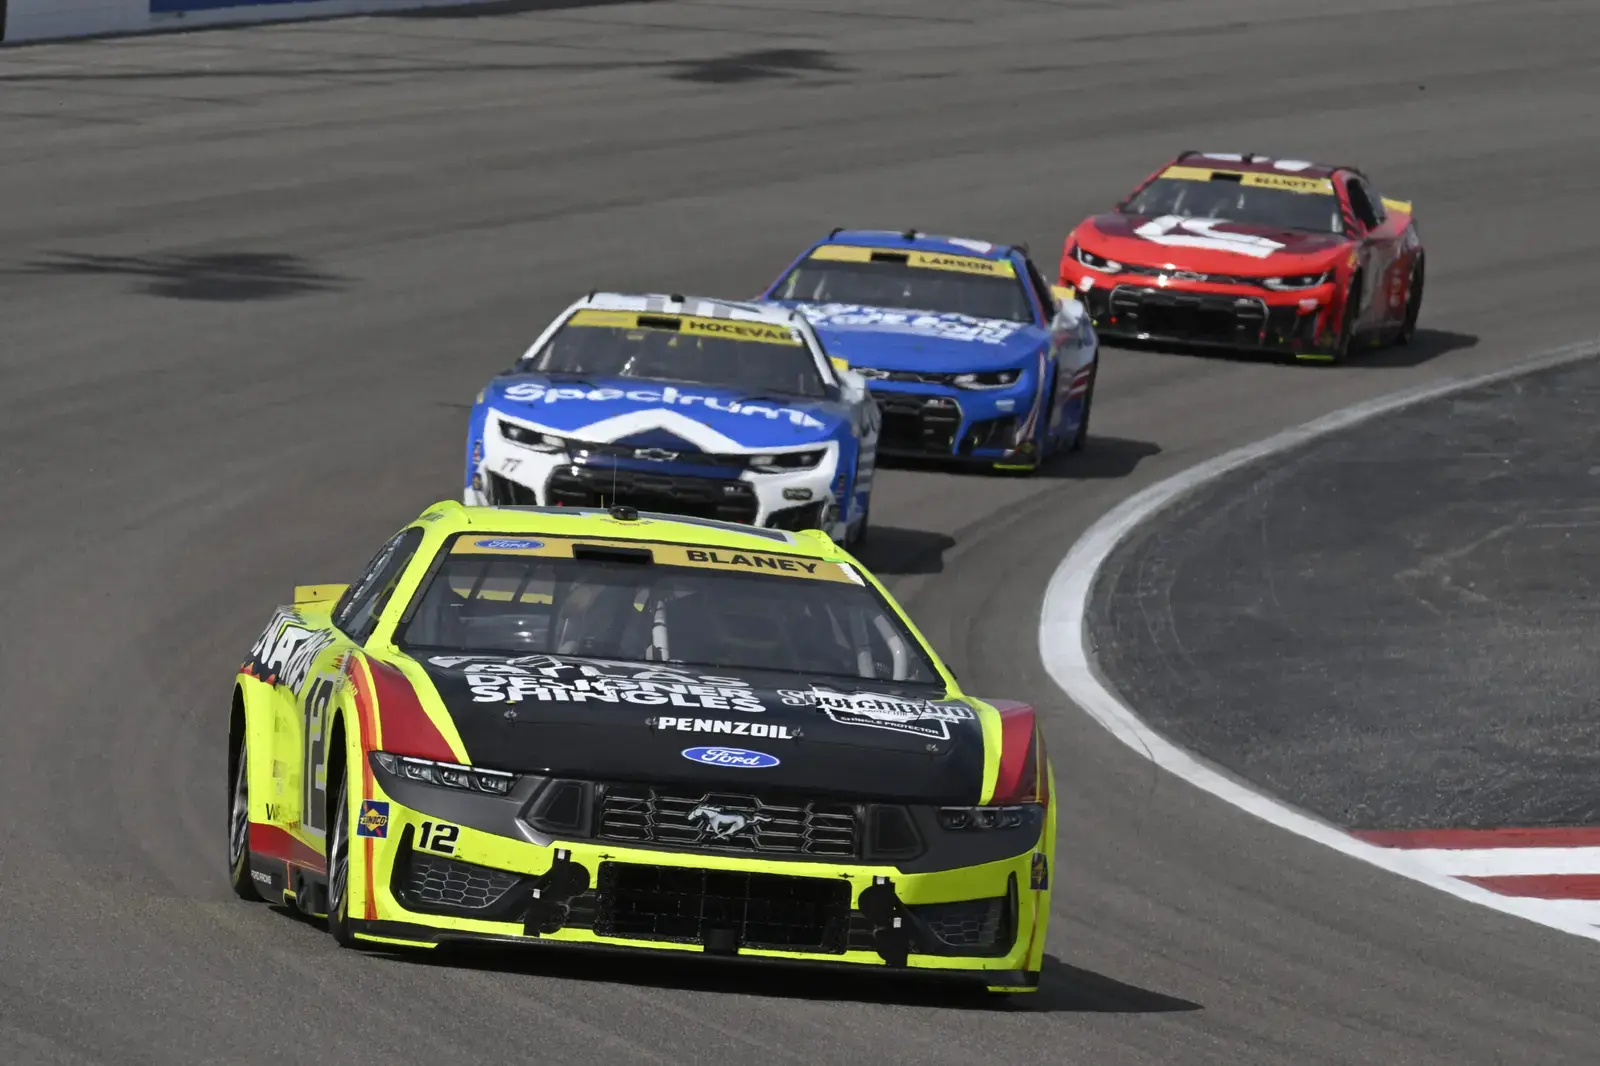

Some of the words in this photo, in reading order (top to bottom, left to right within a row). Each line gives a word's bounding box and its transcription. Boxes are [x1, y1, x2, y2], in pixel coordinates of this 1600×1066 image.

[919, 254, 994, 271] LARSON
[503, 383, 809, 424] Spectrum
[501, 457, 522, 473] 77
[686, 549, 817, 574] BLANEY
[471, 685, 767, 713] SHINGLES
[657, 716, 793, 740] PENNZOIL
[884, 720, 940, 735] PROTECTOR
[700, 747, 761, 767] Ford
[418, 821, 460, 854] 12
